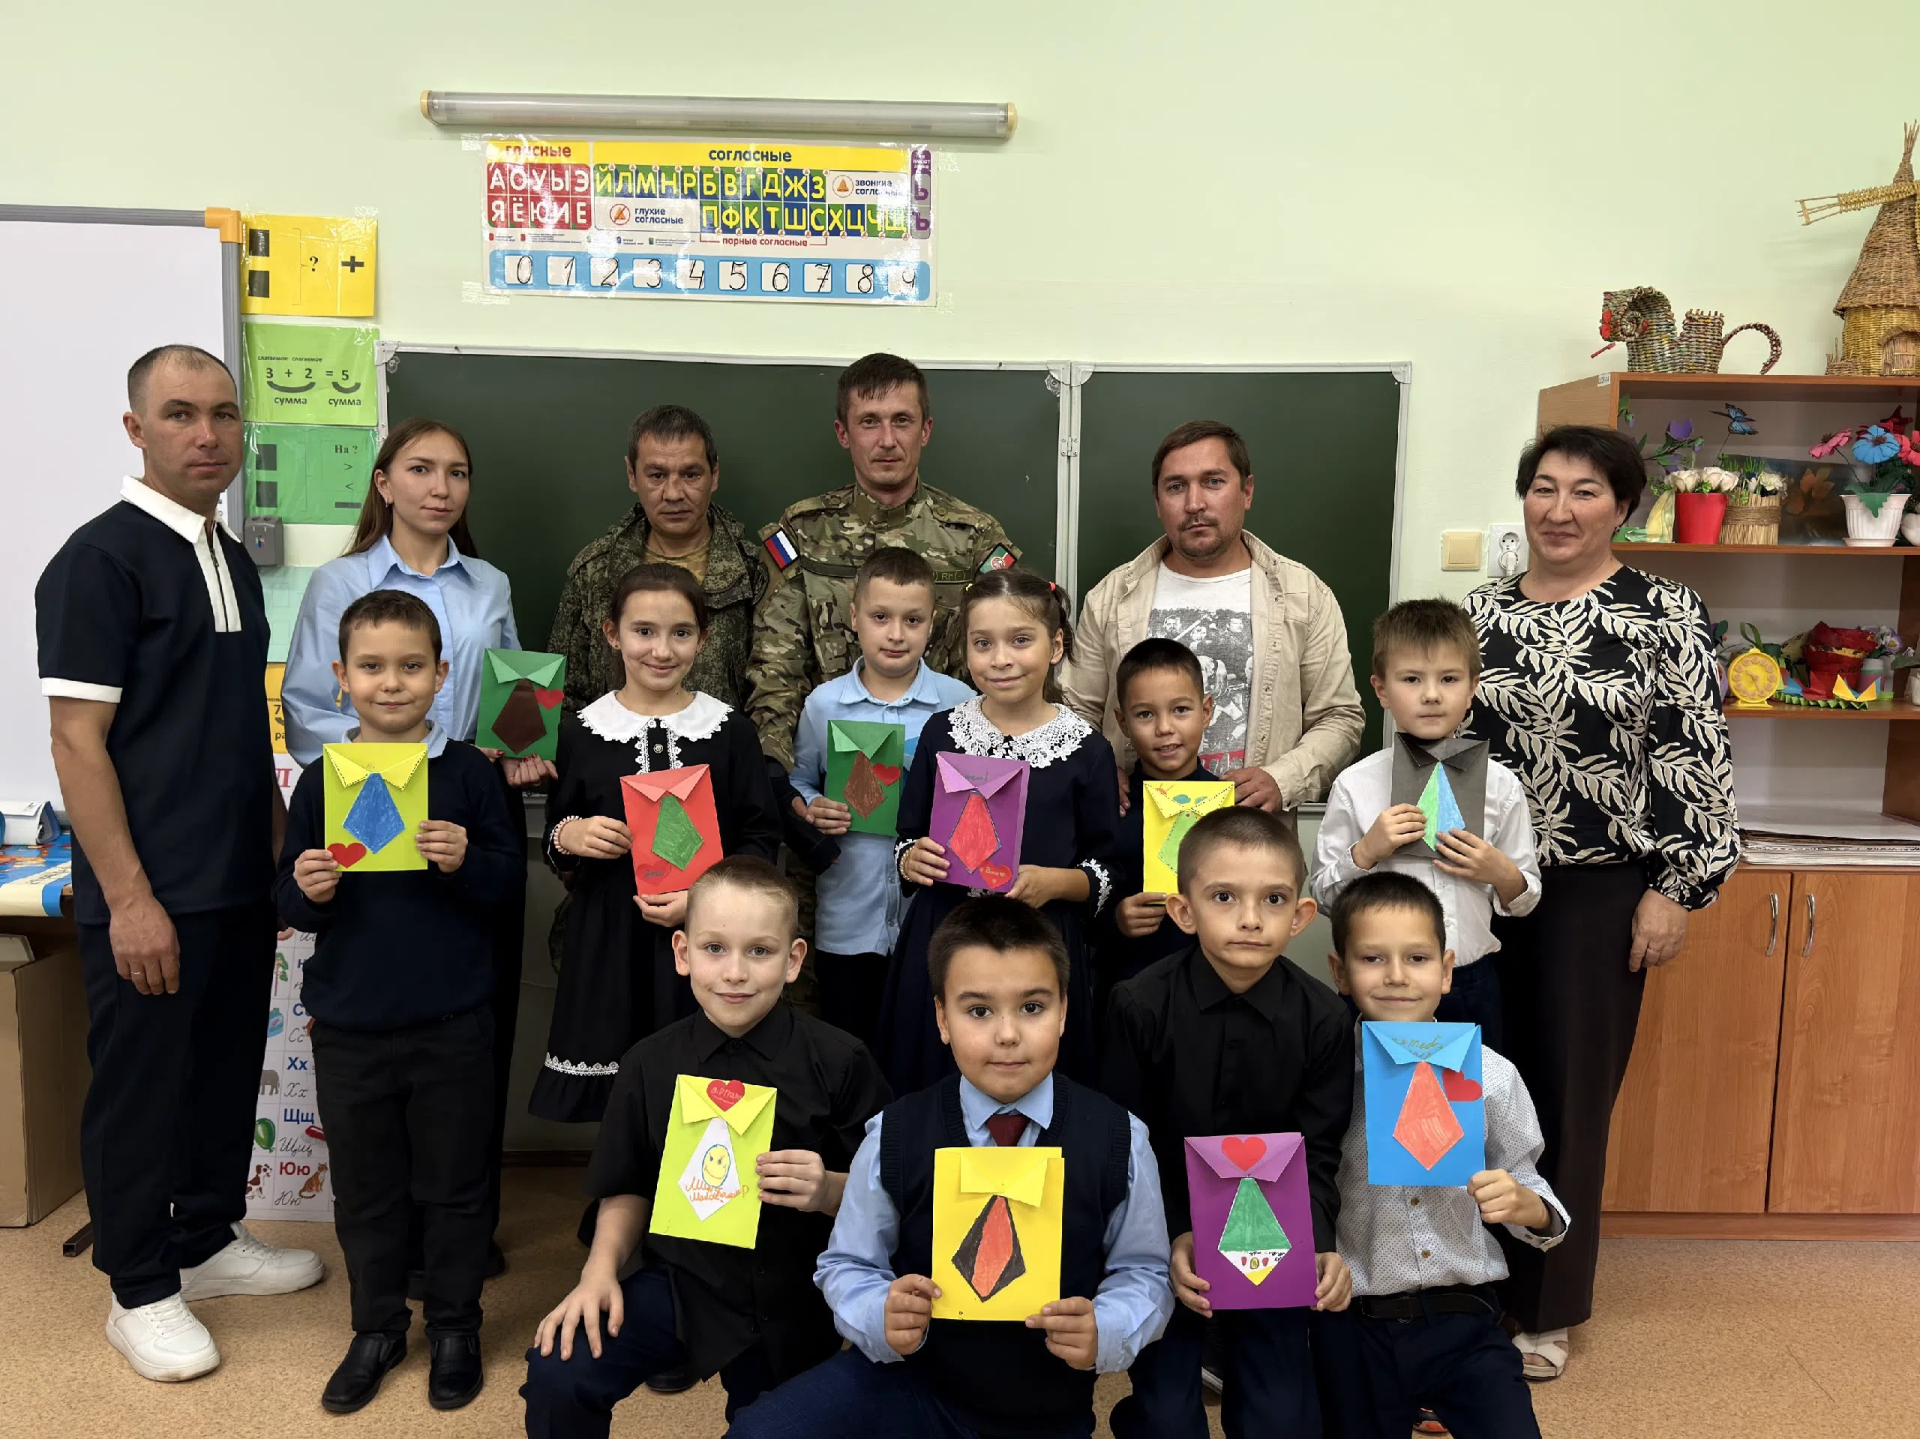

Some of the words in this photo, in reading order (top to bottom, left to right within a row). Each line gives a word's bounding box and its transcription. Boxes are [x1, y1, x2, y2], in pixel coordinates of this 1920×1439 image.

[709, 150, 792, 162] согласные
[634, 208, 666, 216] глухие
[635, 216, 684, 224] согласные
[722, 238, 757, 246] парные
[760, 238, 808, 246] согласные
[516, 255, 532, 284] 0
[564, 256, 576, 286] 1
[601, 258, 618, 286] 2
[646, 259, 662, 288] 3
[689, 260, 704, 289] 4
[729, 261, 746, 290] 5
[772, 262, 790, 292] 6
[814, 264, 831, 292] 7
[858, 264, 874, 294] 8
[902, 267, 915, 290] 9
[266, 368, 274, 378] 3
[305, 368, 312, 379] 2
[342, 370, 349, 380] 5
[274, 397, 307, 406] сумма
[328, 398, 362, 407] сумма
[334, 445, 348, 454] На
[287, 1057, 308, 1070] Хх
[284, 1082, 308, 1098] Хх
[284, 1108, 314, 1124] Щщ
[279, 1137, 312, 1157] Щщ
[280, 1162, 310, 1176] Юю
[274, 1191, 300, 1206] Юю
